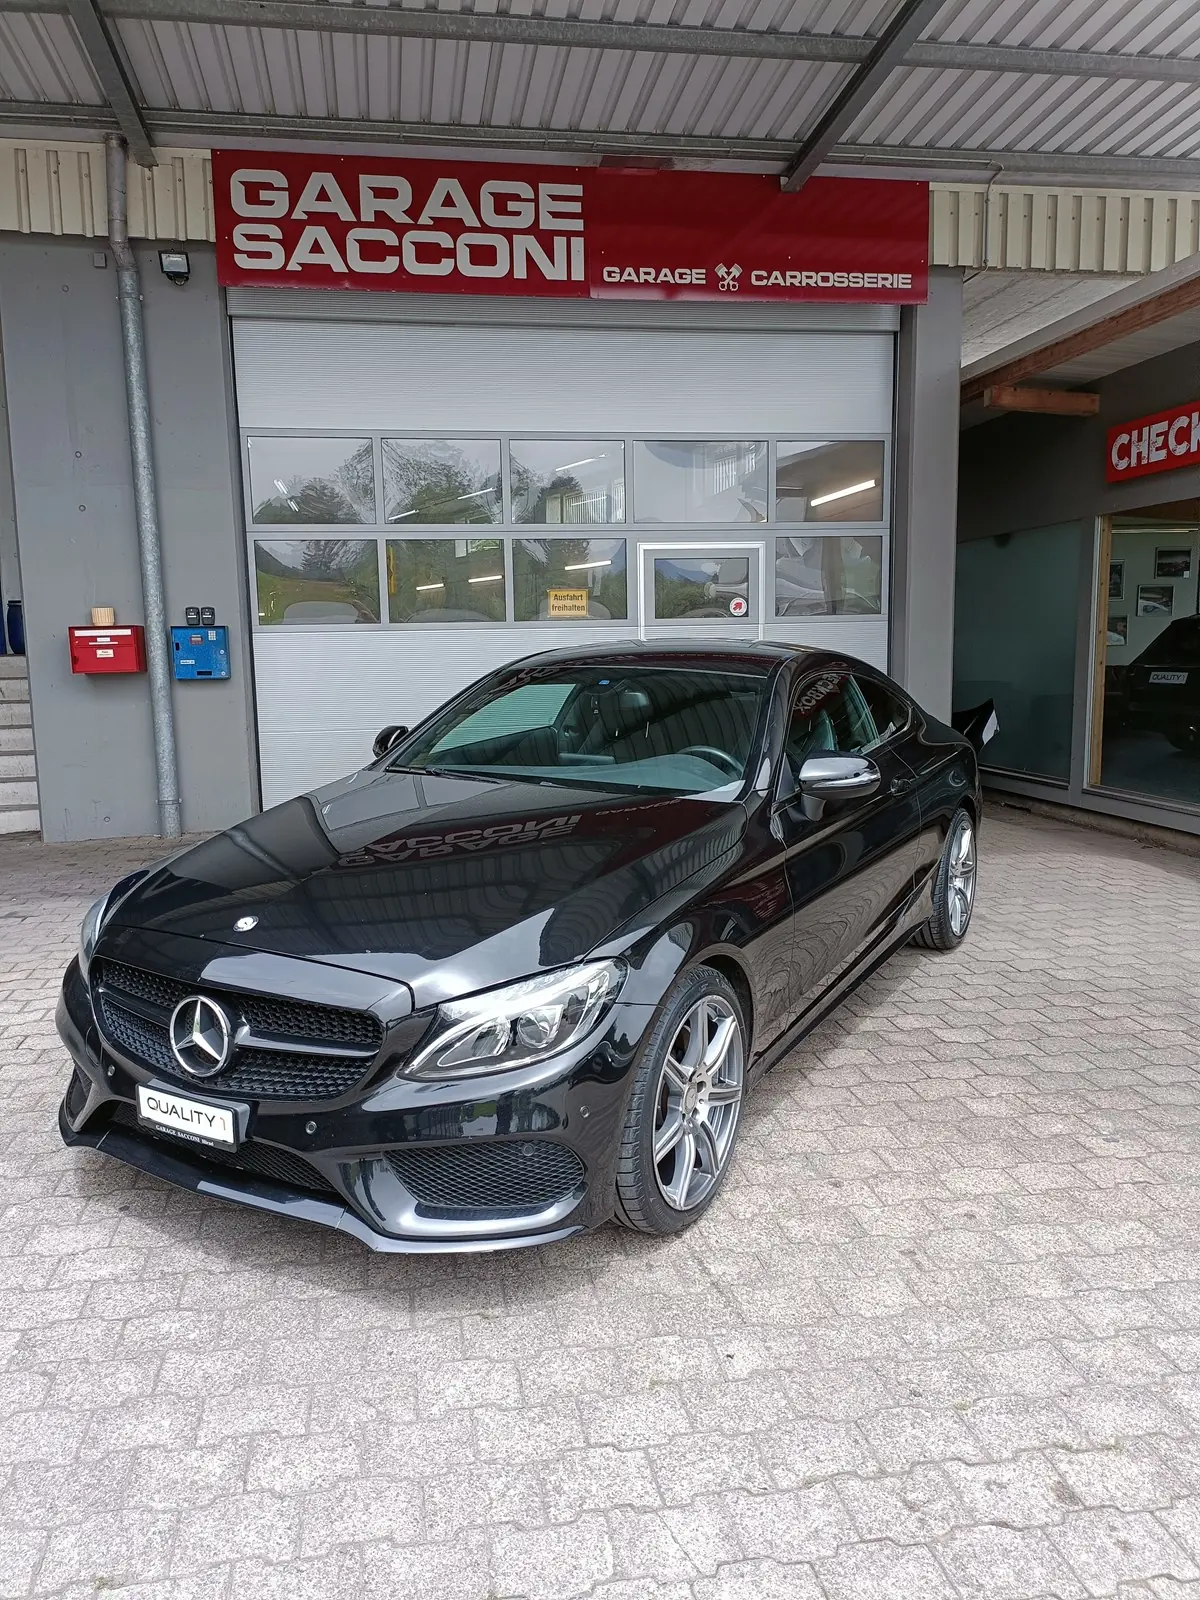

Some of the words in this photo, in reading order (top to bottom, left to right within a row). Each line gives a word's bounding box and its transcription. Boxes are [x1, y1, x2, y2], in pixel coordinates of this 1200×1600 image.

[230, 168, 584, 231] GARAGE
[232, 222, 585, 281] SACCONI
[603, 266, 706, 285] GARAGE
[750, 270, 912, 289] CARROSSERIE
[552, 603, 585, 611] freihalten
[147, 1097, 215, 1127] QUALITY
[155, 1124, 177, 1136] GARAGE
